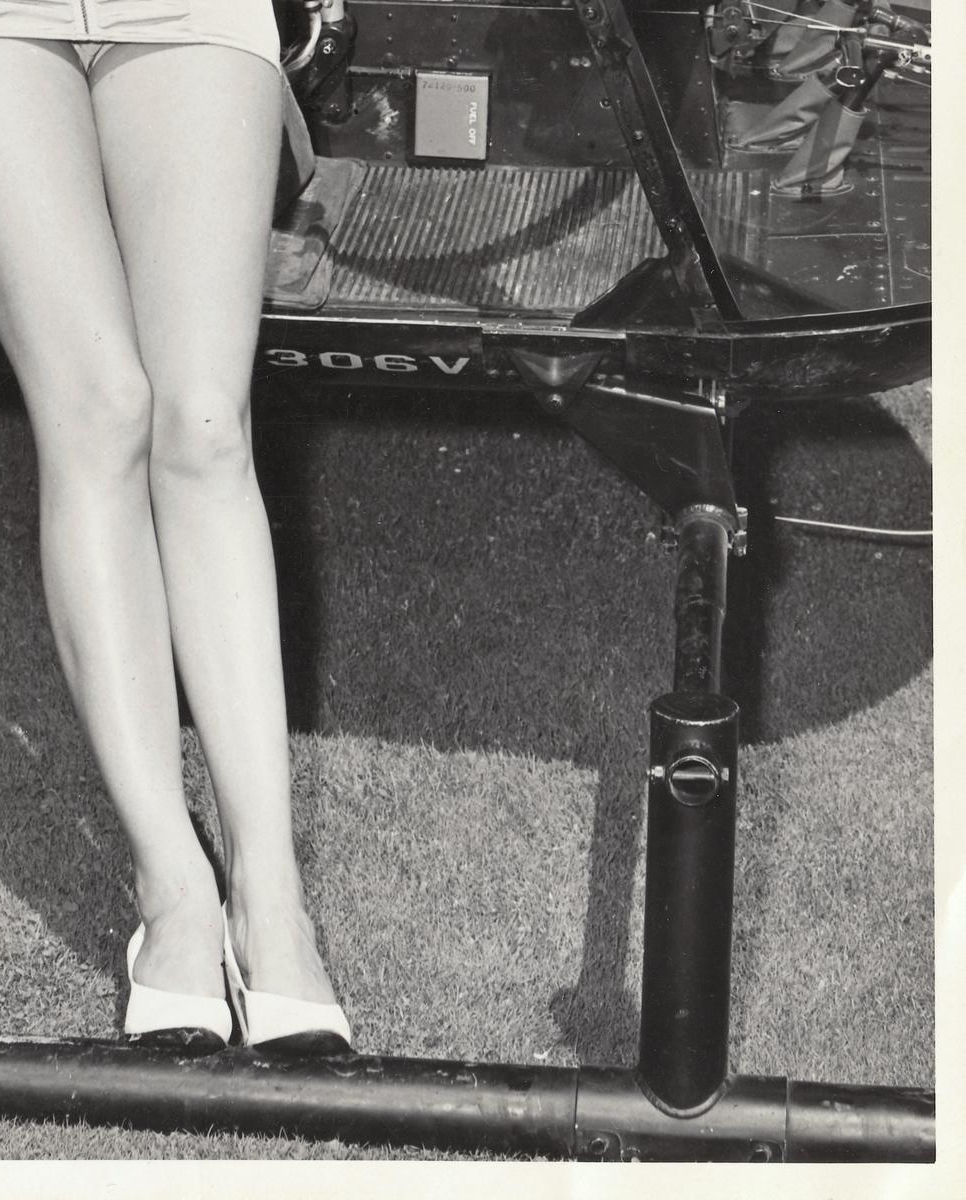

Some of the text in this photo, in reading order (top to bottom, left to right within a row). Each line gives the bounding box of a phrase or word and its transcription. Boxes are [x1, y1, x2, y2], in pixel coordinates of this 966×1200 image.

[468, 102, 477, 145] FUEL OFF
[265, 349, 470, 374] 306V
